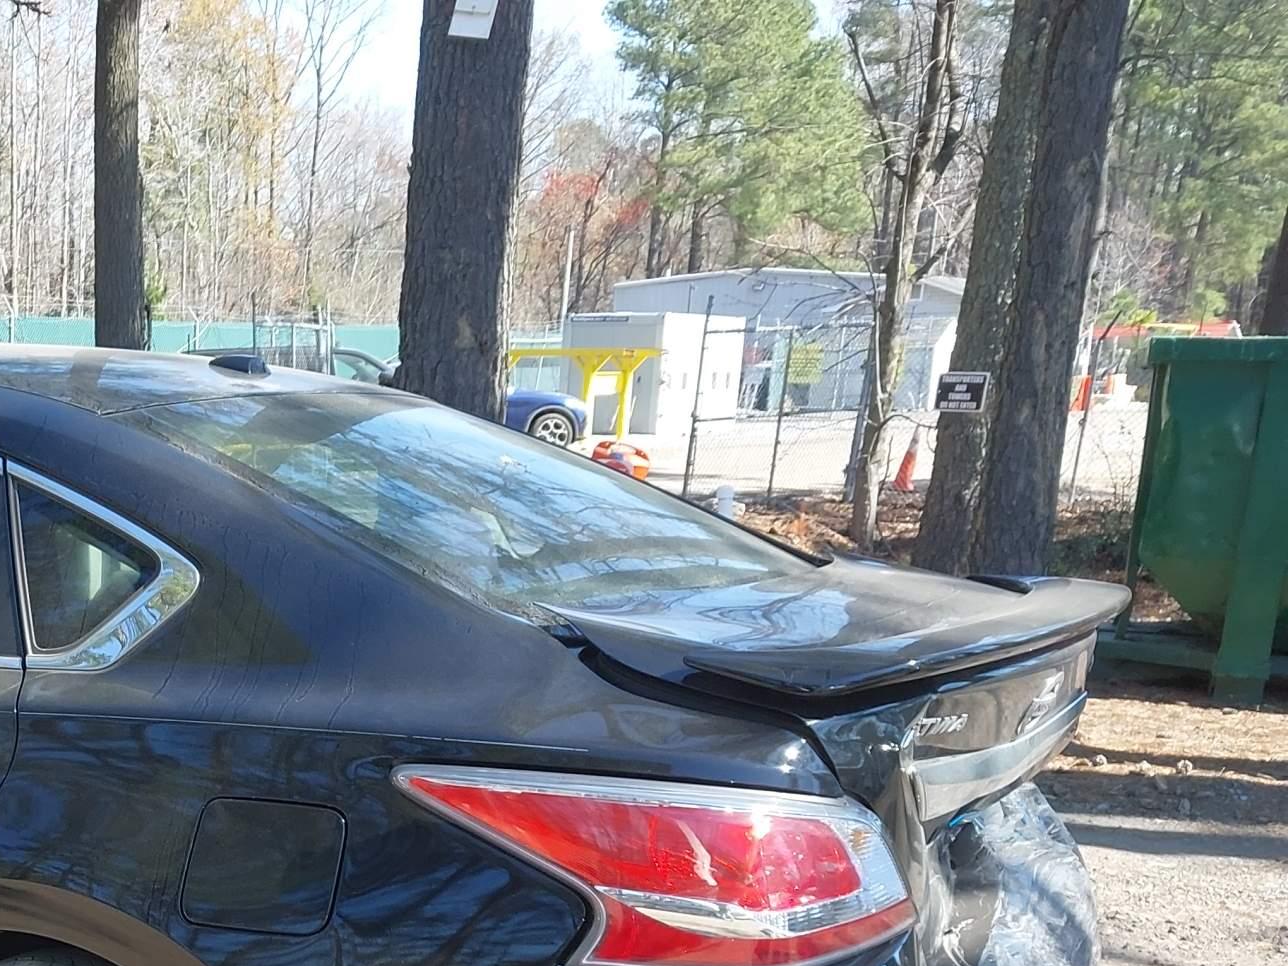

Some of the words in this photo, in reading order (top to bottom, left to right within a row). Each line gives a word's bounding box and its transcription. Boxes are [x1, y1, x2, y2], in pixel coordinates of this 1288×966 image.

[942, 375, 985, 383] TRANSPORTERS
[948, 401, 960, 409] NOT
[960, 401, 977, 409] ENTER
